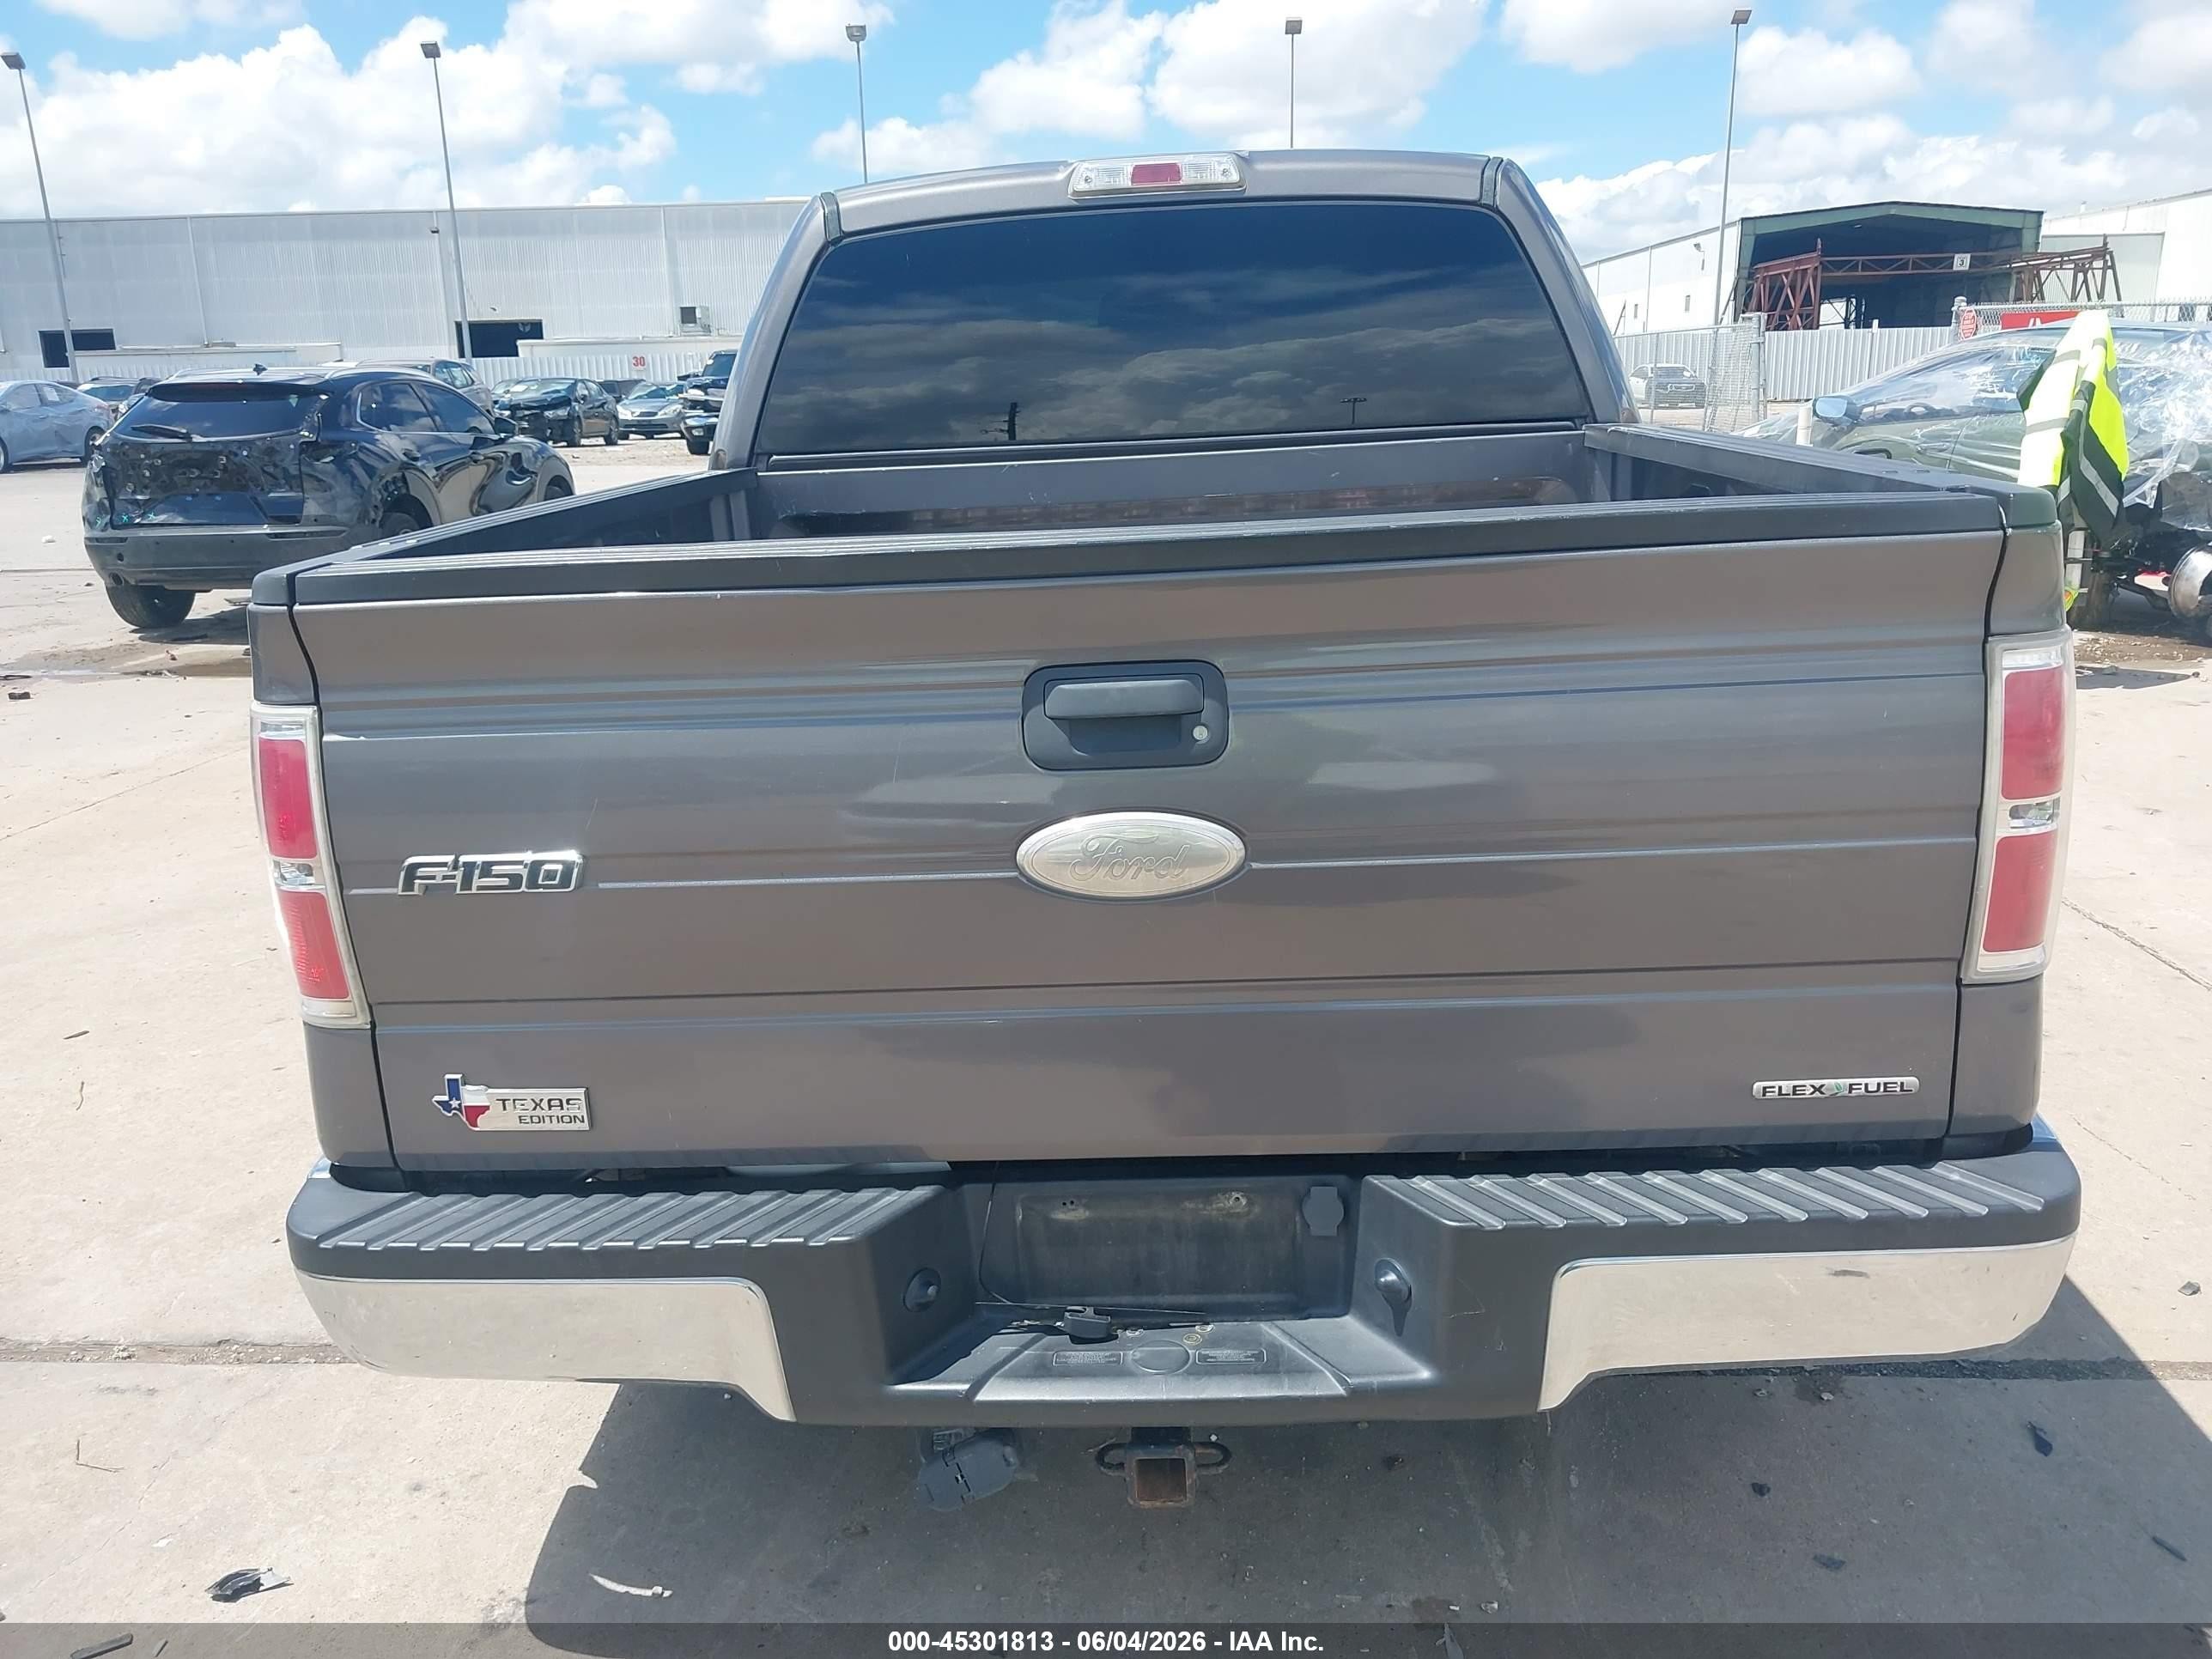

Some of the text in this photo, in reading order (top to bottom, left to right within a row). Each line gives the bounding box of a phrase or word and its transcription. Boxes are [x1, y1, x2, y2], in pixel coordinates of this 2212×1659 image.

[632, 356, 646, 367] 30
[1070, 833, 1190, 882] Ford
[398, 850, 584, 896] F-150
[1761, 1082, 1913, 1097] FLEX FUEL
[495, 1098, 582, 1112] TEXAS
[519, 1115, 586, 1125] EDITION
